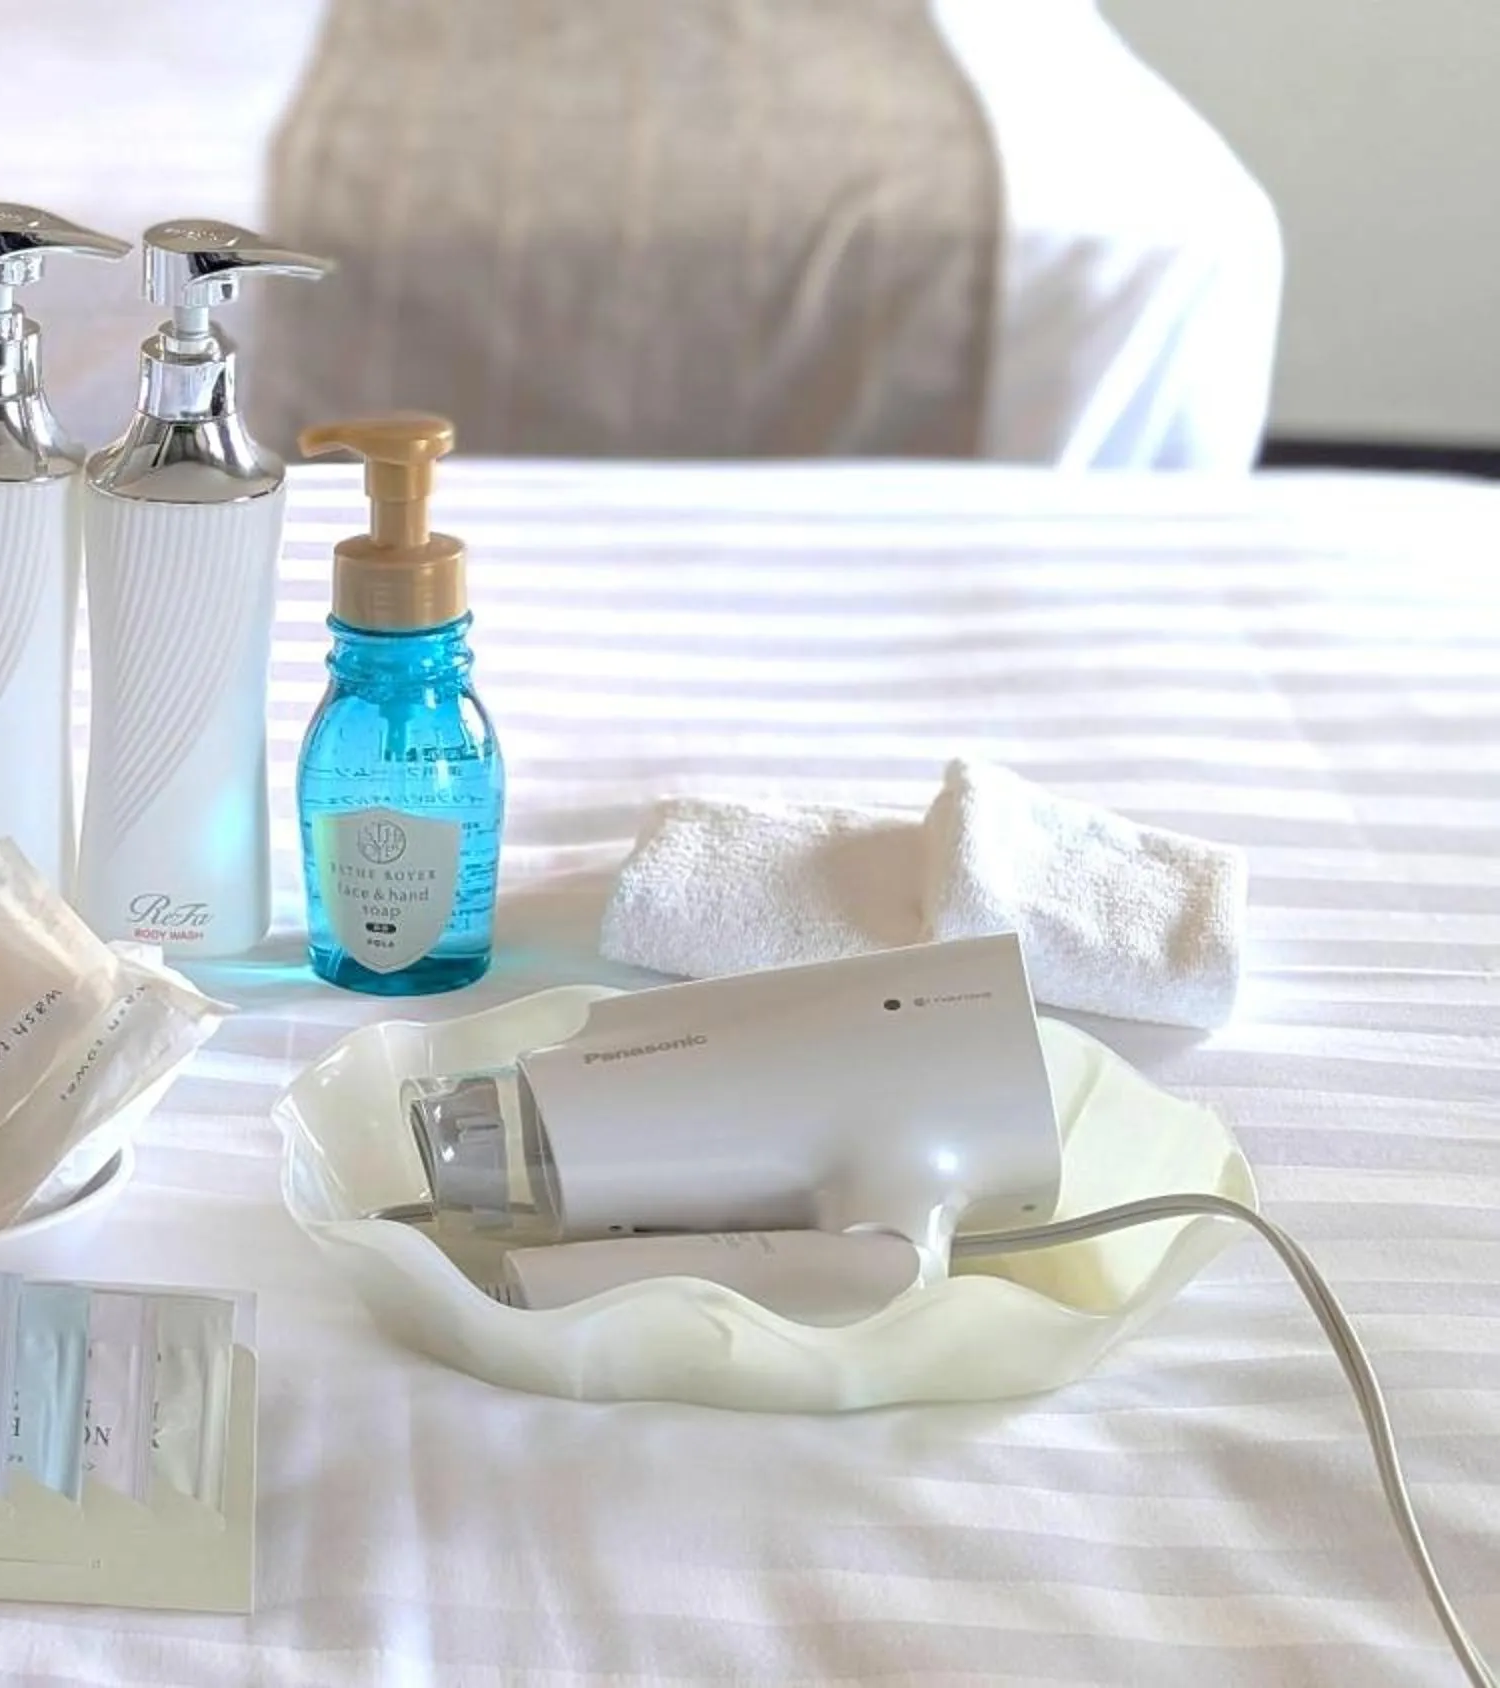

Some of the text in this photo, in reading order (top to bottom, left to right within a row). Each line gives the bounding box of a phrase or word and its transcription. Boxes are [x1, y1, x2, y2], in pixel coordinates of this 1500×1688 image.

[338, 881, 370, 899] face
[388, 886, 429, 902] hand
[126, 892, 214, 927] ReFa
[362, 904, 402, 921] soap
[12, 989, 63, 1036] wash
[584, 1034, 708, 1065] Panasonic
